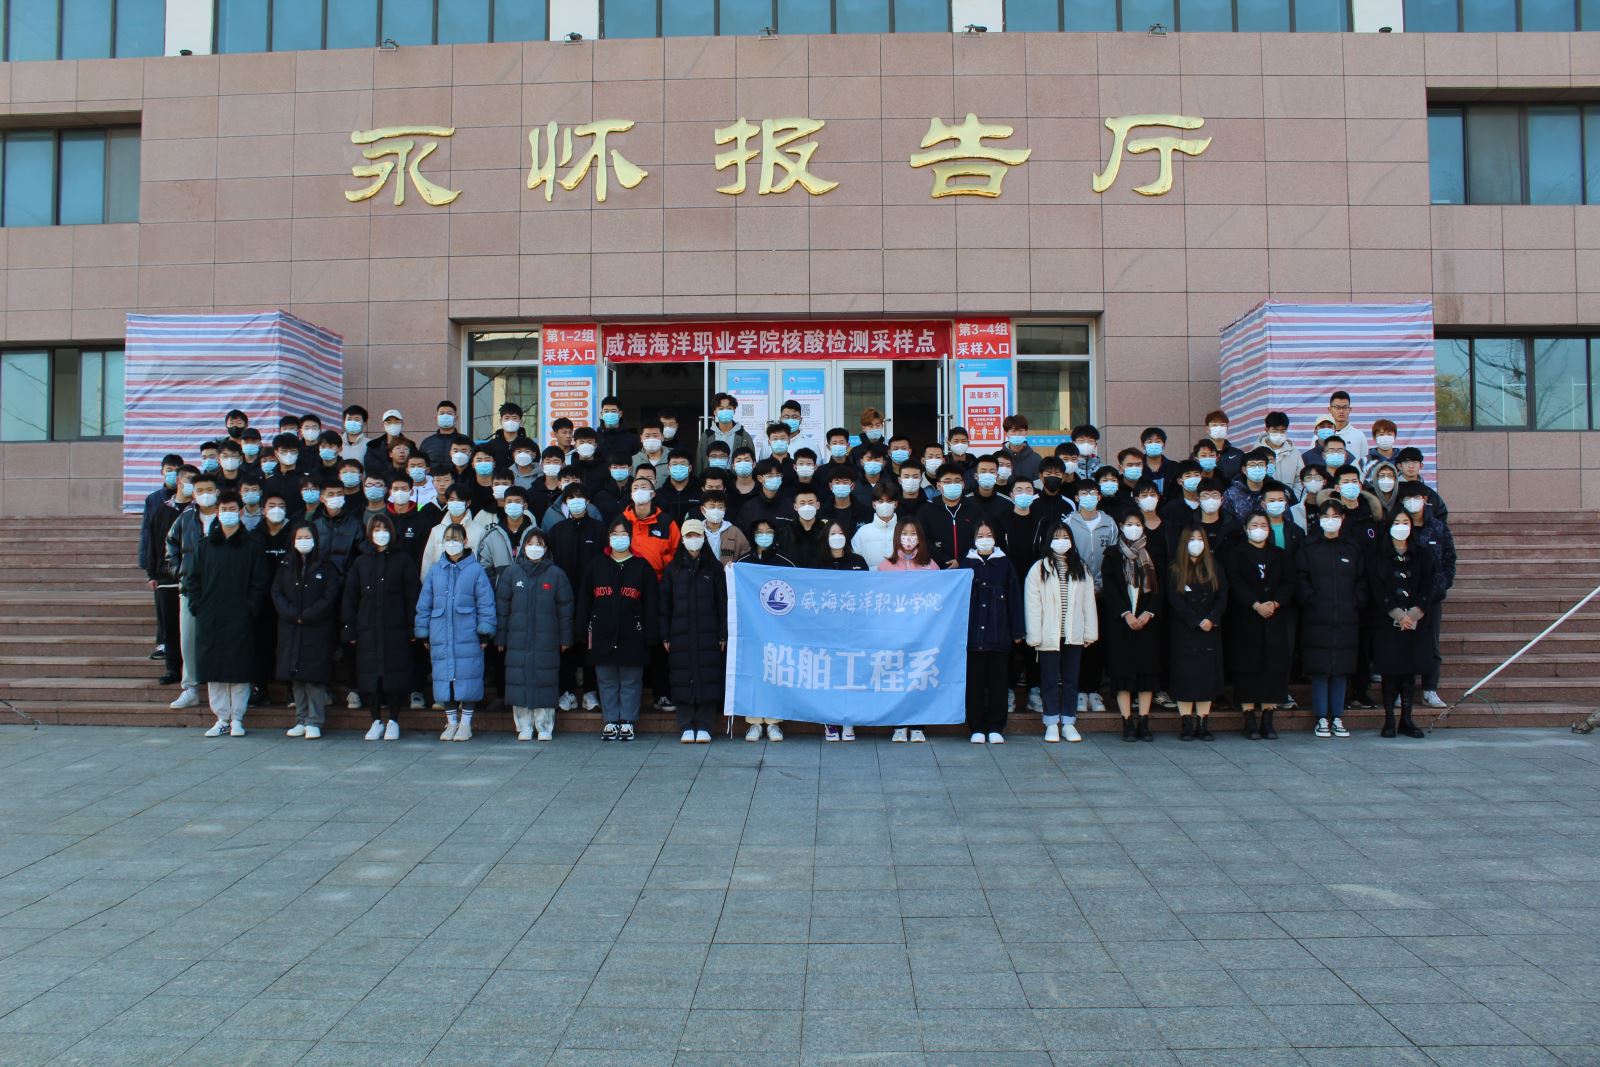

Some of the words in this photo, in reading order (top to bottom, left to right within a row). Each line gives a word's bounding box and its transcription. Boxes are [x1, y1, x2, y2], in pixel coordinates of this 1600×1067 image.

[344, 112, 1213, 206] 永怀报告厅
[546, 328, 595, 343] 第1-2组
[957, 322, 1009, 337] 第3-4组
[604, 327, 937, 357] 威海海洋职业学院核酸检测采样点
[957, 342, 1010, 356] 采样入口
[544, 348, 596, 362] 采样入口
[801, 588, 943, 616] 威海海洋职业学院
[763, 641, 941, 692] 船舶工程系
